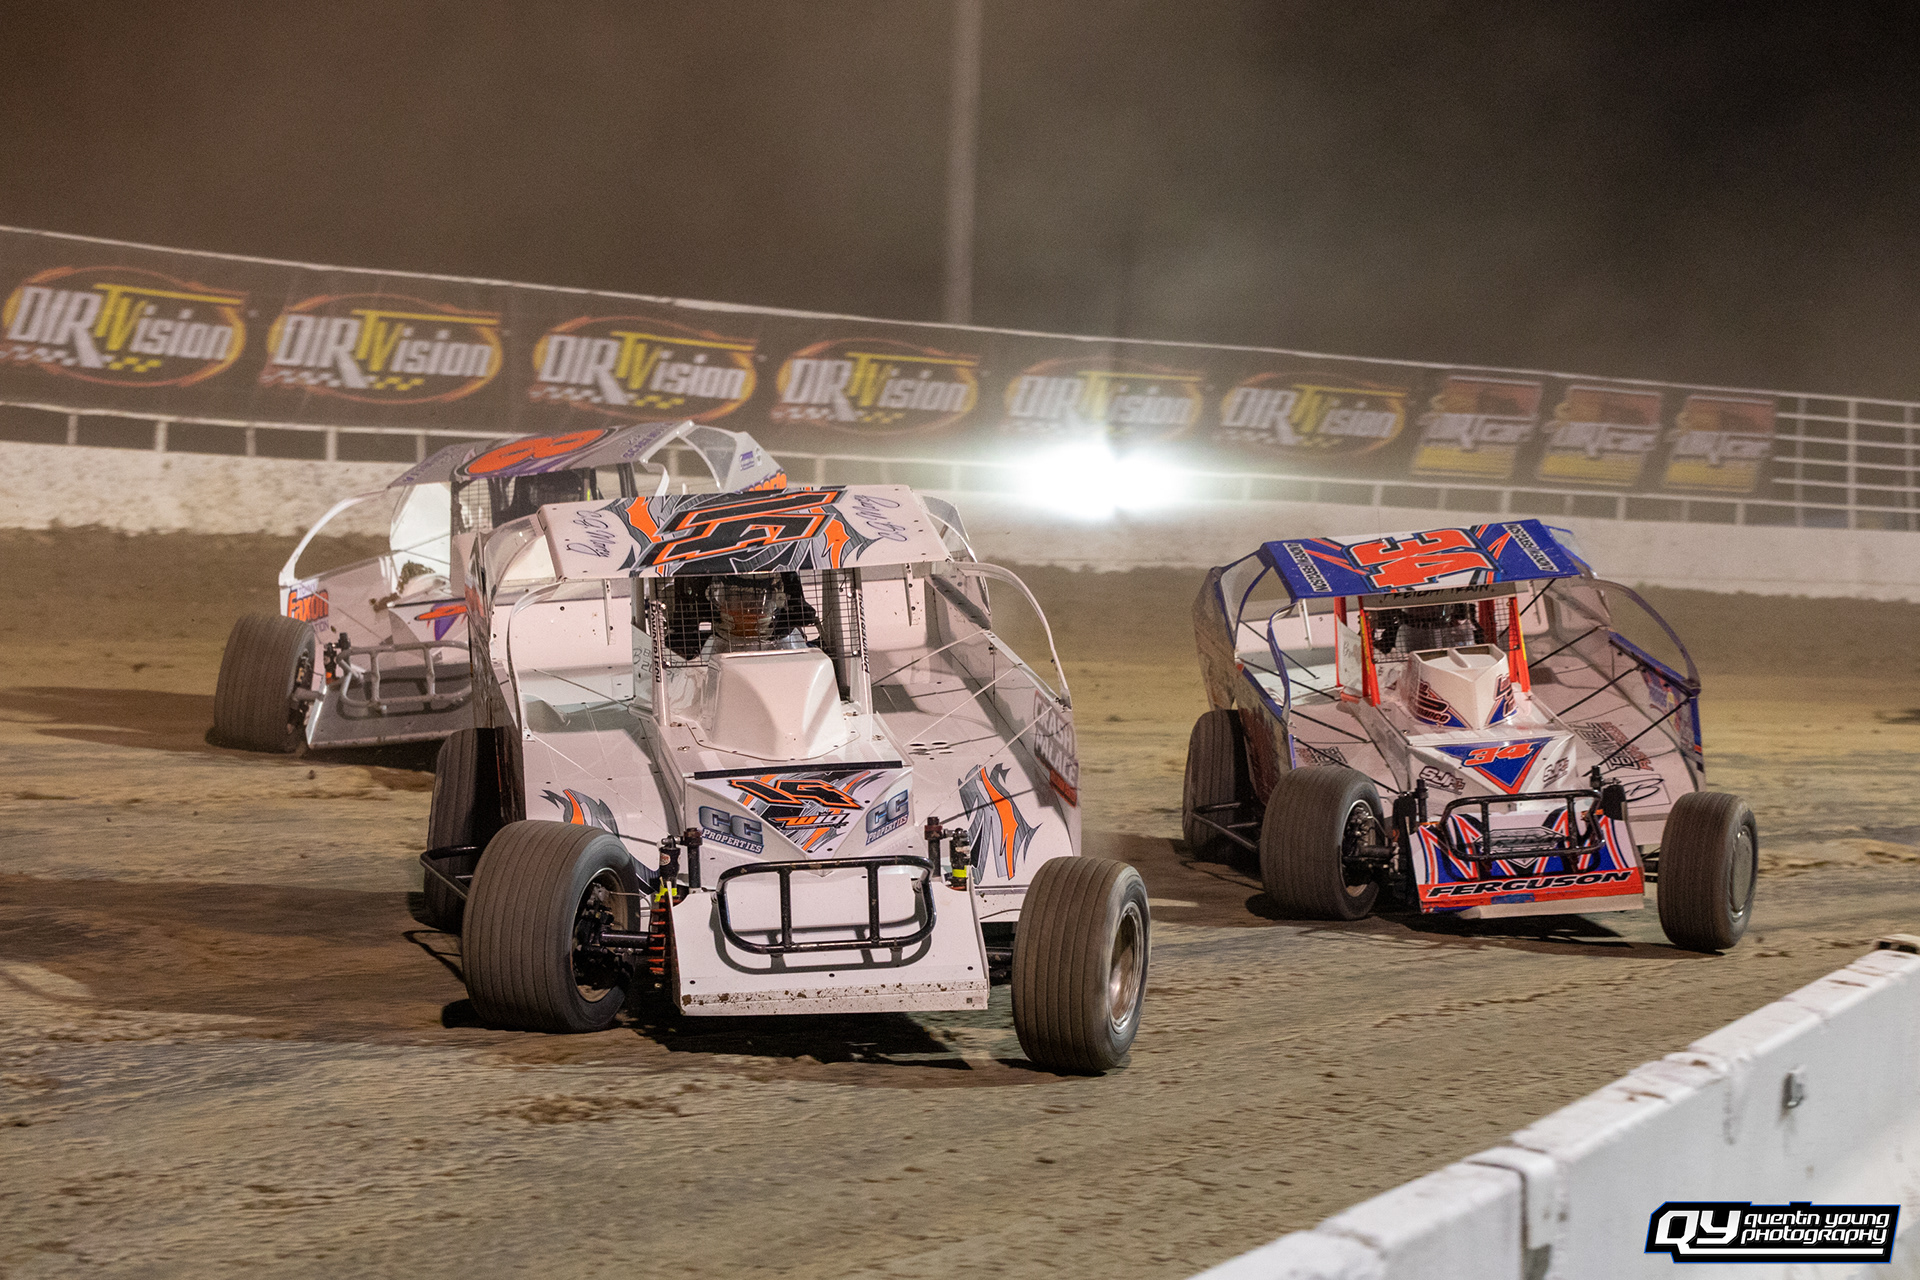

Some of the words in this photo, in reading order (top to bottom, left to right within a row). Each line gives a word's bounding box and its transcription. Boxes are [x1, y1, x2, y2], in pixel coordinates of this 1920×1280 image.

[1464, 742, 1534, 766] 34
[701, 827, 763, 854] PROPERTIES
[866, 814, 908, 845] PROPERTIES
[1426, 870, 1632, 899] FERGUSON
